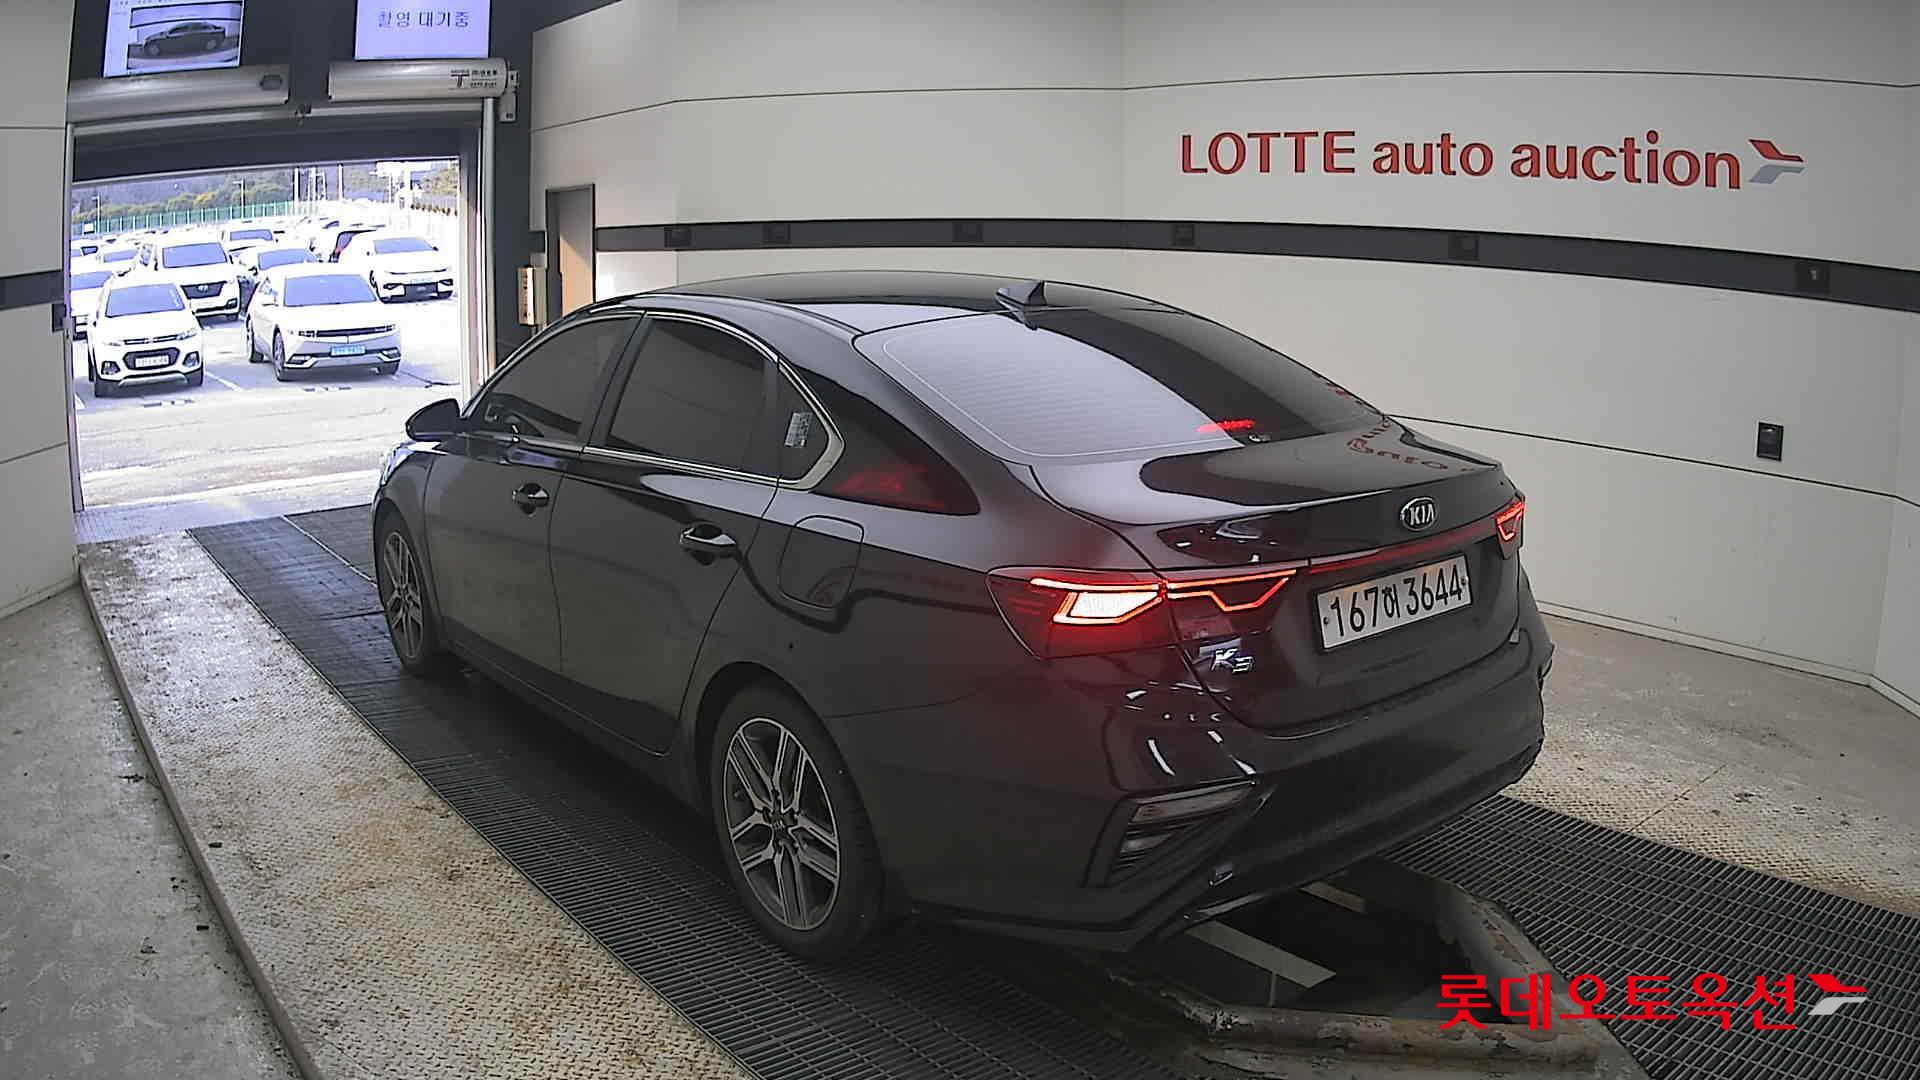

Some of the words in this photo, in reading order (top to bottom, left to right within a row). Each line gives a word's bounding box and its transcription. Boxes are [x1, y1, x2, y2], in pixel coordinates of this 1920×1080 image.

[1181, 131, 1356, 174] LOTTE
[1372, 133, 1494, 177] auto
[1511, 130, 1741, 189] auction
[1408, 503, 1435, 526] KIA
[1330, 584, 1401, 637] 167허
[1403, 564, 1463, 616] 3644
